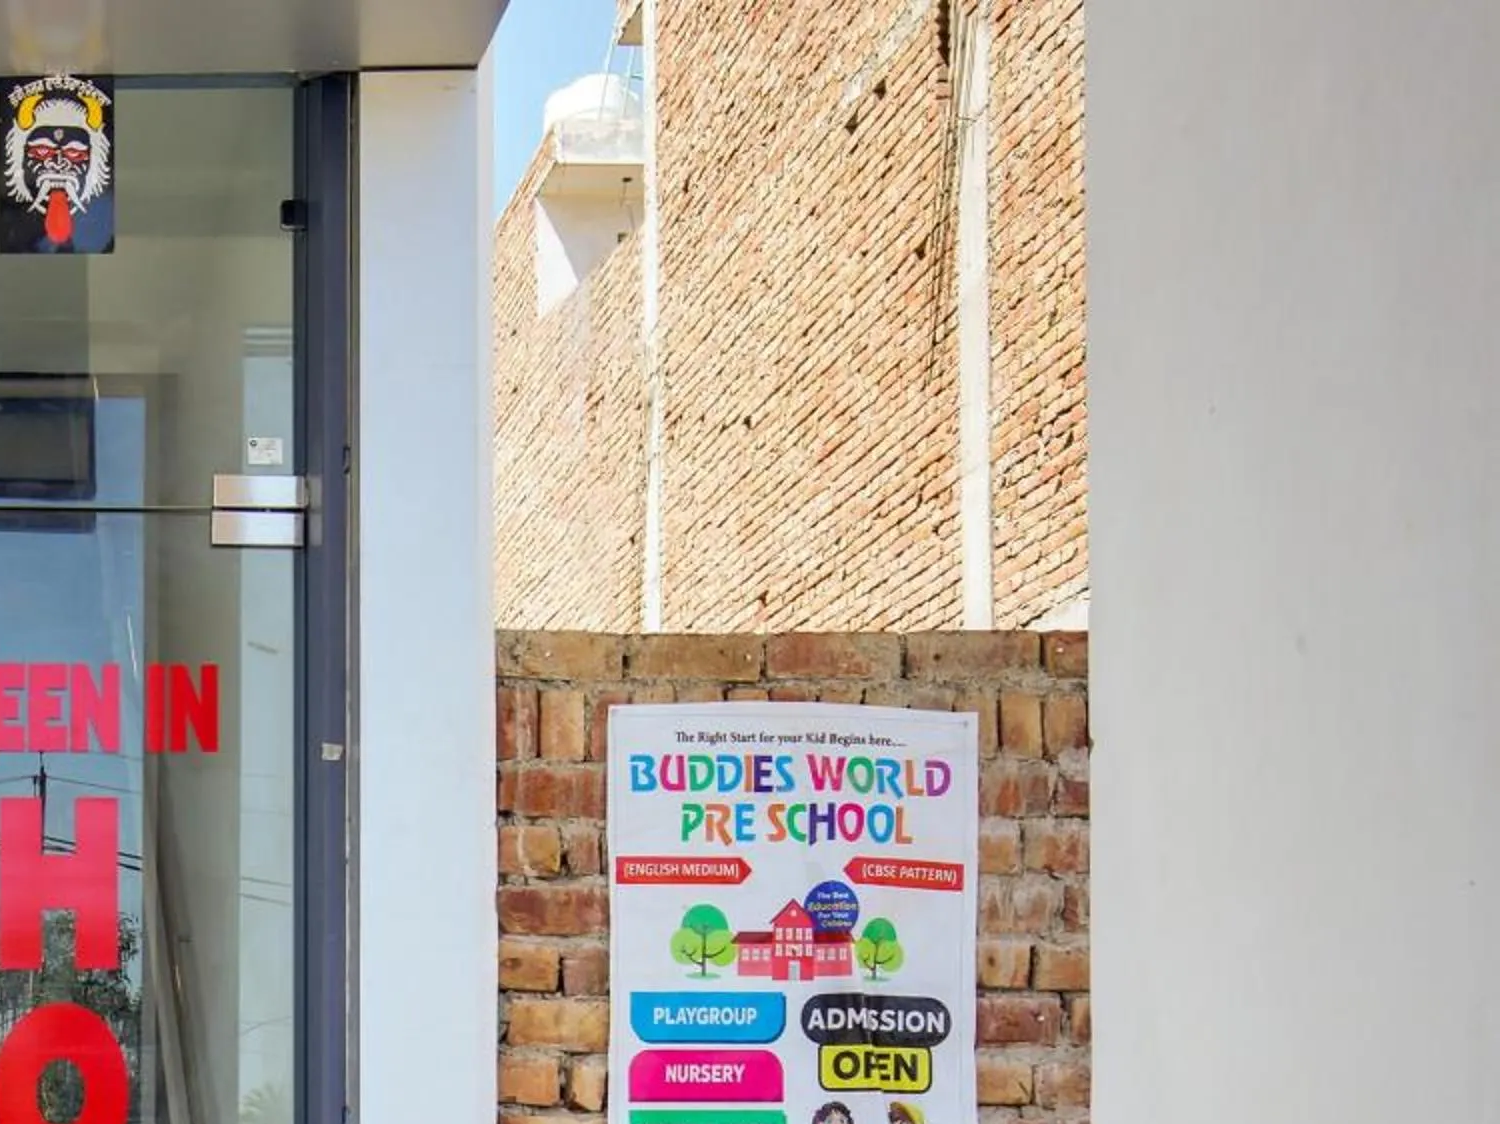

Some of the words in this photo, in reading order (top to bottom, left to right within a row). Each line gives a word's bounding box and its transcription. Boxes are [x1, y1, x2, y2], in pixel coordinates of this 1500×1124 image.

[146, 663, 220, 753] IN
[676, 731, 695, 743] The
[697, 731, 727, 746] Right
[730, 732, 757, 744] Start
[759, 731, 775, 743] for
[777, 734, 802, 746] your
[805, 732, 826, 744] Kid
[829, 733, 866, 748] Begins
[629, 754, 796, 793] BUDDIES
[807, 753, 952, 799] WORLD
[681, 803, 756, 846] PRE
[767, 802, 913, 847] SCHOOL
[681, 863, 739, 878] MEDIUM)
[862, 863, 898, 880] (CBSE
[899, 866, 958, 887] PATTERN)
[653, 1007, 758, 1025] PLAYGROUP
[665, 1064, 746, 1083] NURSERY
